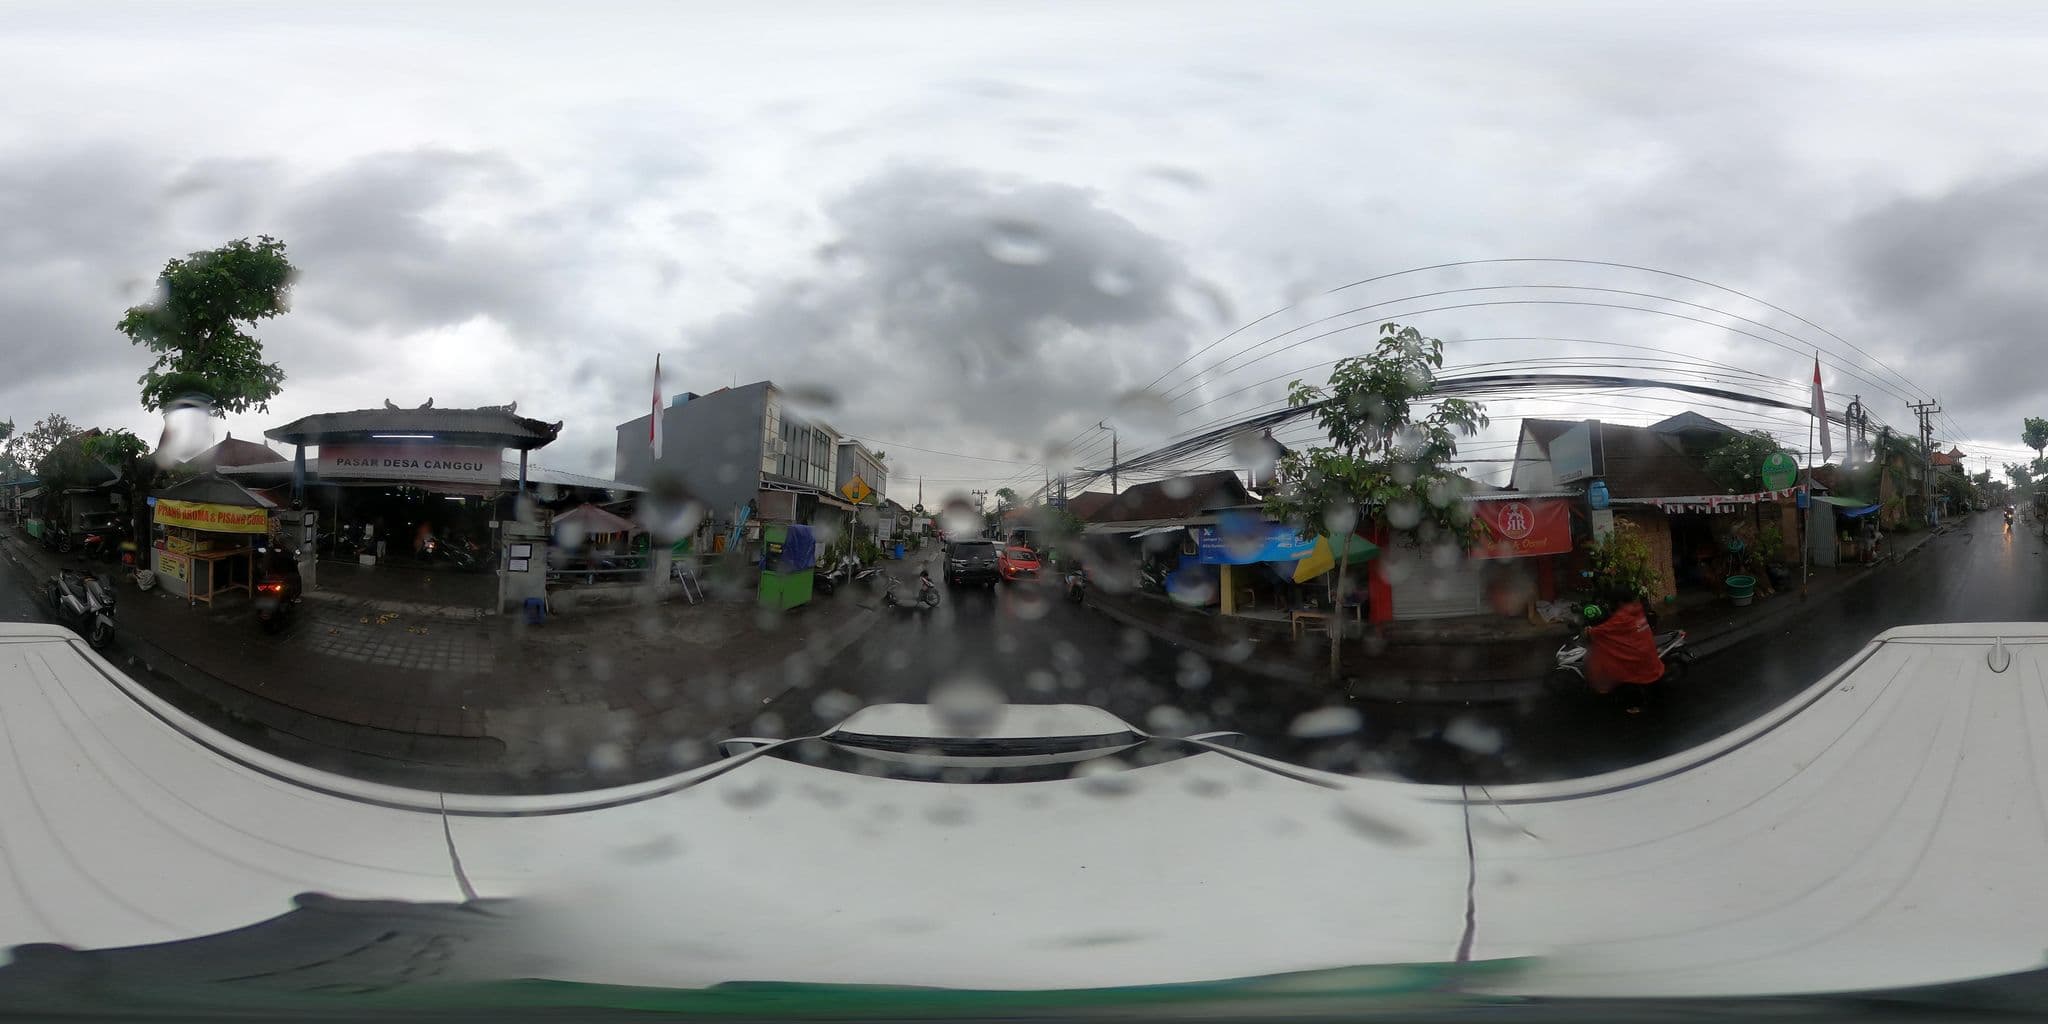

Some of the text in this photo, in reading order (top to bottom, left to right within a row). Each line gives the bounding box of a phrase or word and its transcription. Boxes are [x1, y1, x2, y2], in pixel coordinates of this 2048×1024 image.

[336, 458, 483, 472] PASAR DESA CANGGU
[210, 513, 216, 523] &
[217, 512, 246, 525] PISANG
